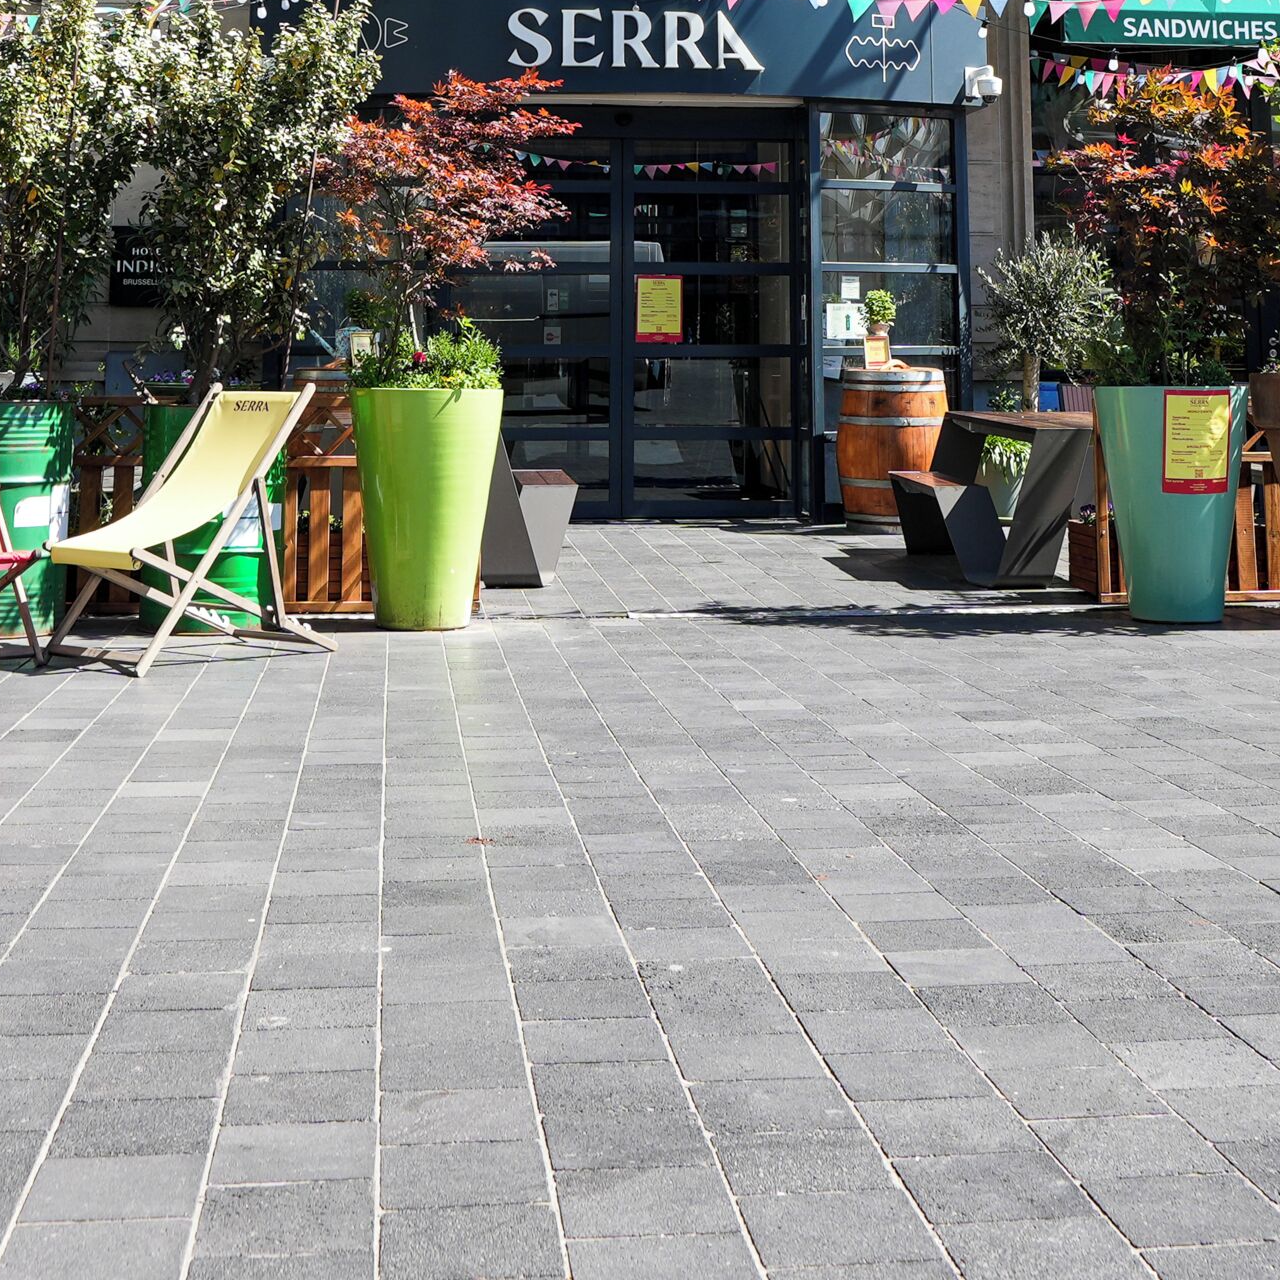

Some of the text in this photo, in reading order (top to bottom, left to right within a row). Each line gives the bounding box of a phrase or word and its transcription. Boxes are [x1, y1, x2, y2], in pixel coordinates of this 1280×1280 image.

[1123, 17, 1278, 41] SANDWICHES
[507, 7, 765, 72] SERRA
[131, 247, 162, 256] HOE
[116, 260, 174, 273] INDI
[122, 278, 159, 286] BRUSSEL
[233, 400, 269, 412] SERRA
